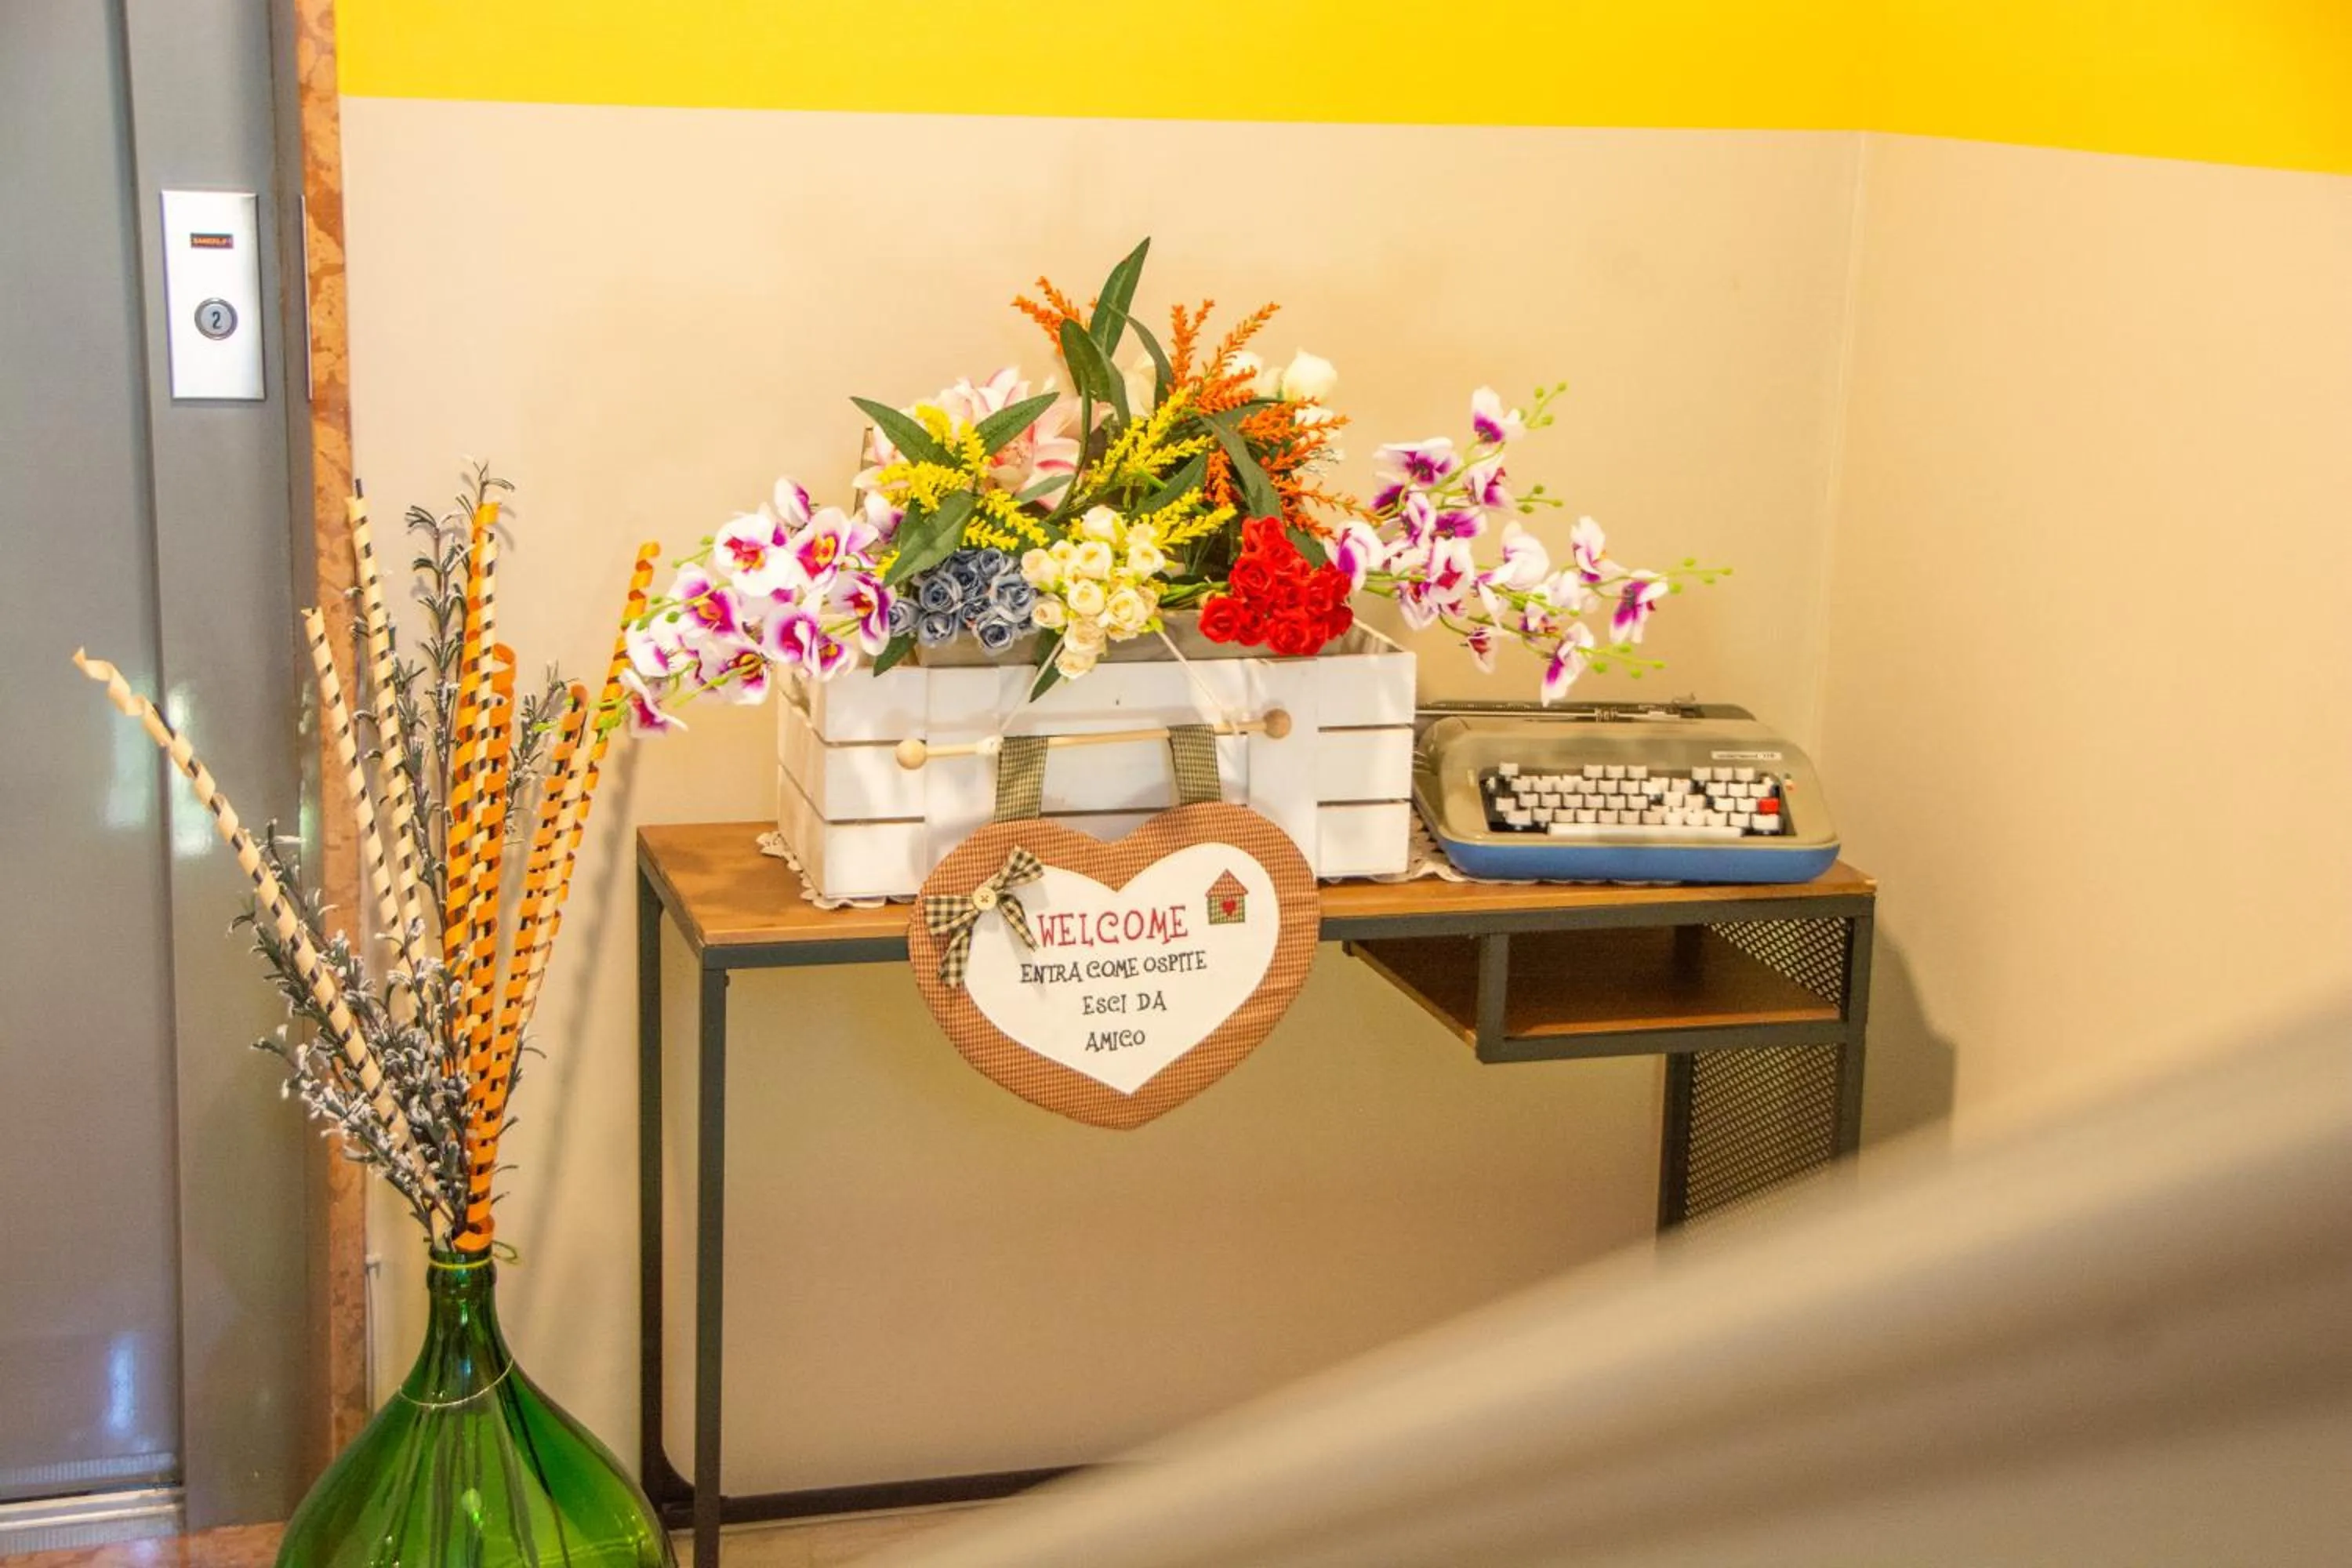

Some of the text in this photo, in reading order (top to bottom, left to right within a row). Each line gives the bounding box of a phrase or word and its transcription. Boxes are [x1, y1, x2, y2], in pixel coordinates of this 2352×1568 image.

[212, 311, 222, 329] 2
[1036, 906, 1189, 948] WELCOME
[1019, 950, 1207, 984] ENTRA COME OSPITE
[1082, 990, 1167, 1015] ESCI DA
[1085, 1029, 1145, 1053] AMICO
